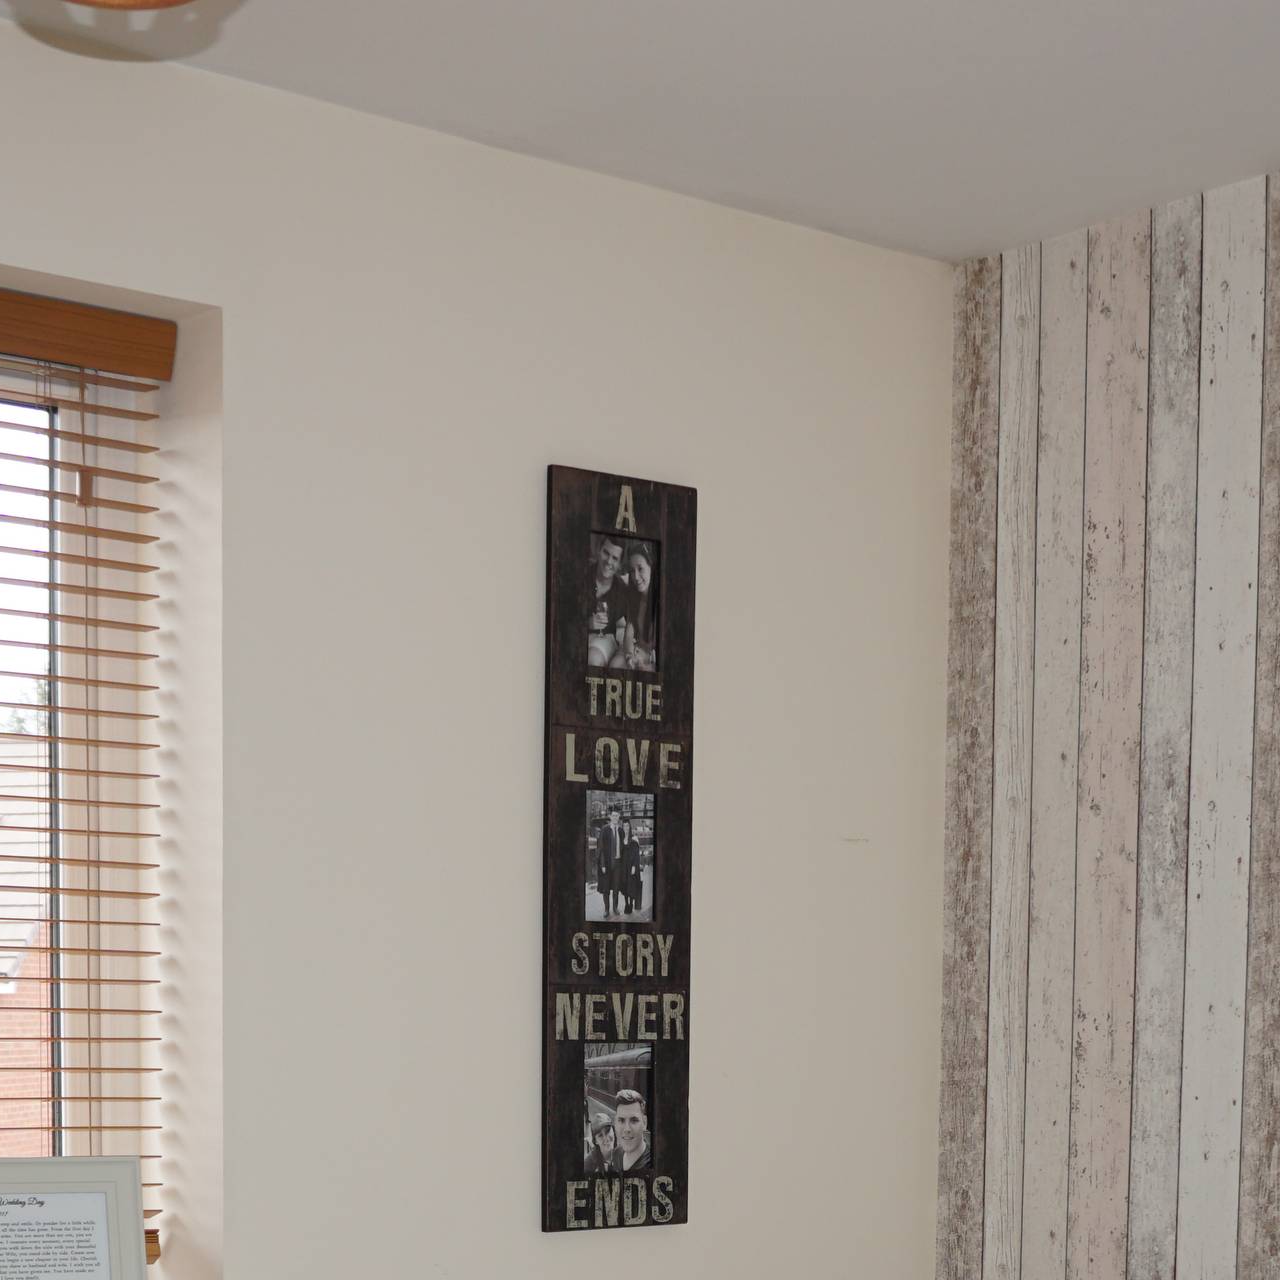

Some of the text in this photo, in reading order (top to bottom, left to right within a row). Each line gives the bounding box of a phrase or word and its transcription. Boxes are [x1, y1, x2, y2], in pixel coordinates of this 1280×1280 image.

[615, 485, 637, 533] A
[585, 676, 662, 721] TRUE
[565, 733, 682, 789] LOVE
[571, 932, 674, 977] STORY
[555, 992, 685, 1041] NEVER
[27, 1196, 45, 1207] Day
[566, 1175, 674, 1229] ENDS
